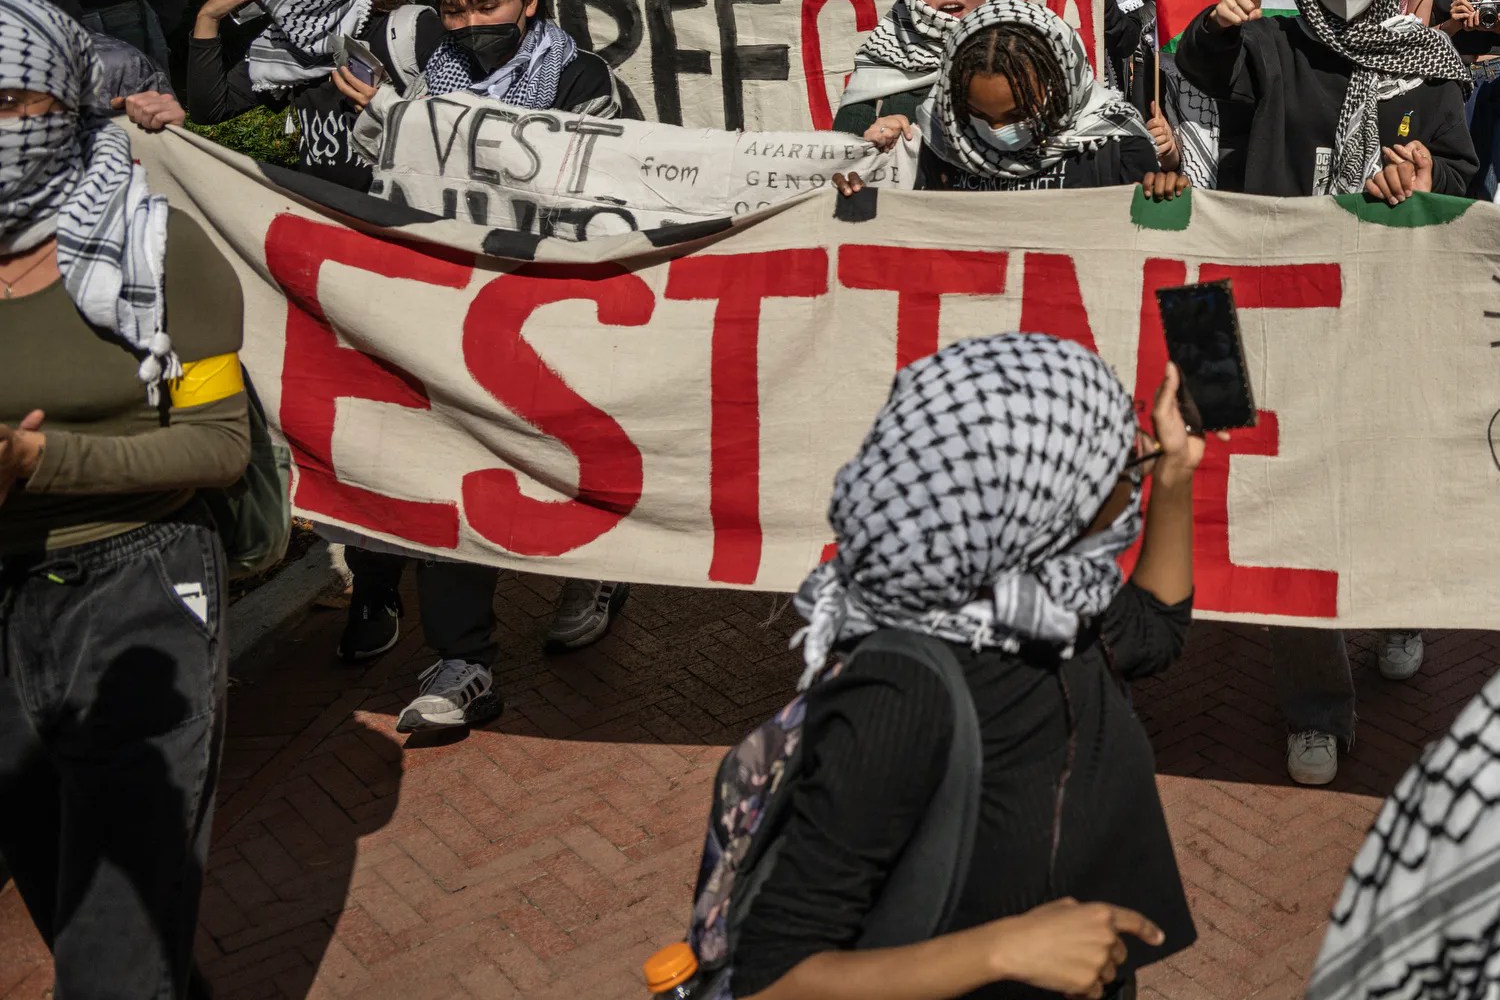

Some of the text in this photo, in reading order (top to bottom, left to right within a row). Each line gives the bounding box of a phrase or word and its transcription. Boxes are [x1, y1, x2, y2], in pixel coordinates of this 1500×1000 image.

[379, 97, 625, 195] IVEST
[640, 156, 700, 186] from
[743, 141, 876, 161] APARTHEI
[746, 166, 900, 190] GENODE
